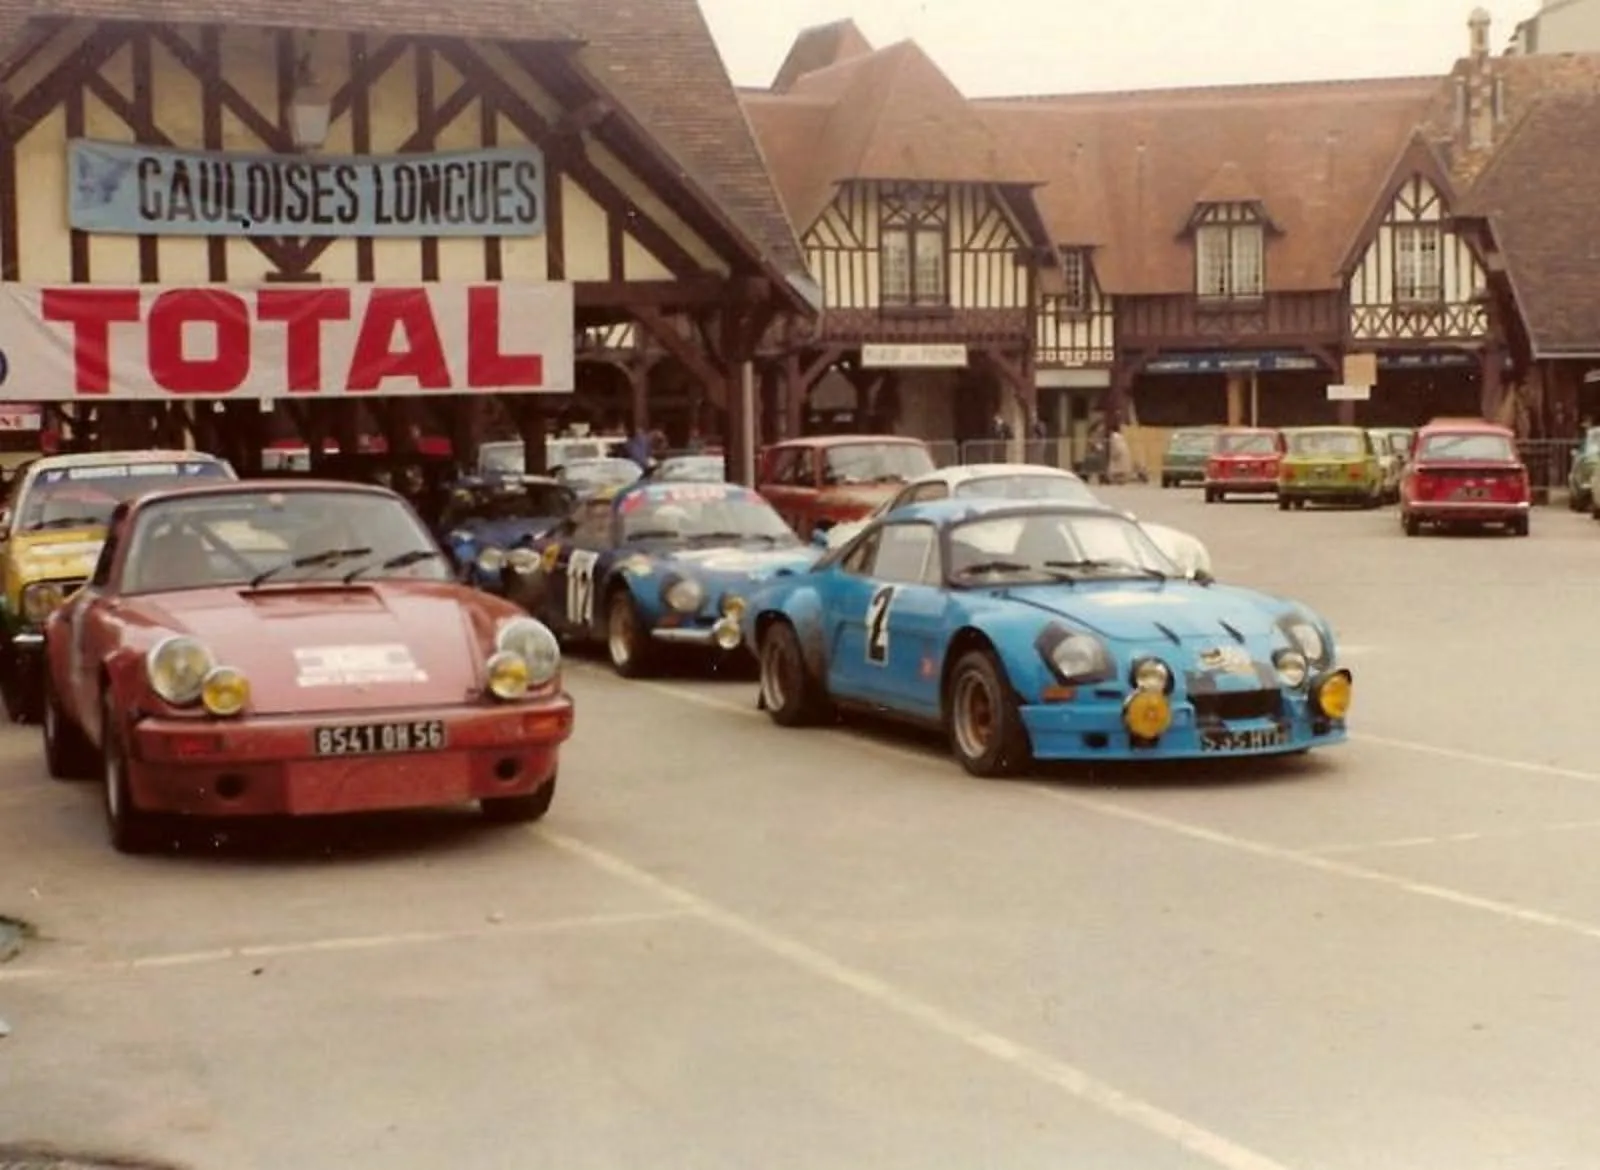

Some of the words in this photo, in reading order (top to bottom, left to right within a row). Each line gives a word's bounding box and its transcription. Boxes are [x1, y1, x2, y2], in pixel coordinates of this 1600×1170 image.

[138, 156, 359, 224] GAULOISES
[373, 160, 538, 225] LONGUES
[42, 286, 543, 394] TOTAL
[868, 586, 894, 661] 2
[318, 726, 375, 755] 8541
[413, 721, 442, 749] 56
